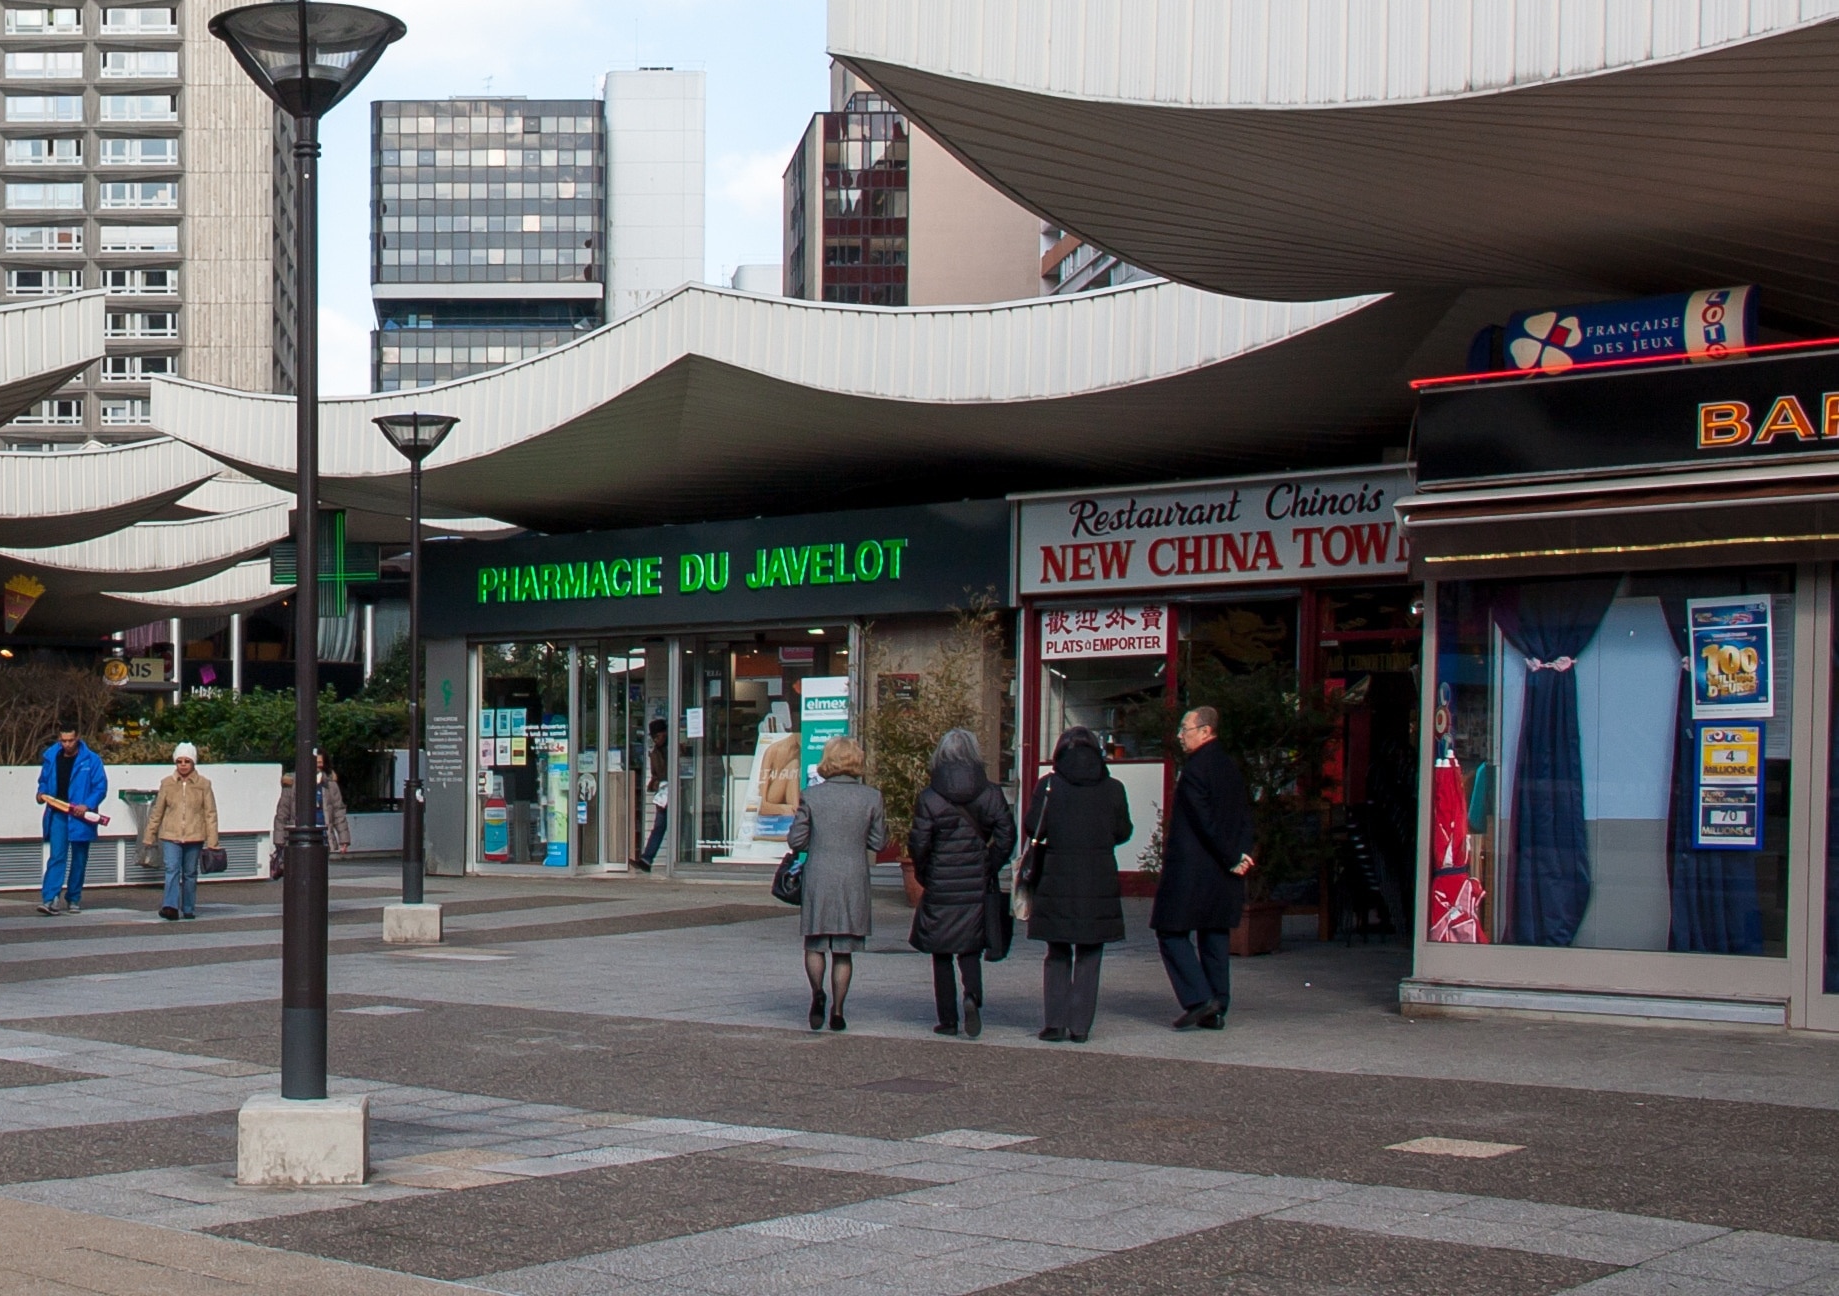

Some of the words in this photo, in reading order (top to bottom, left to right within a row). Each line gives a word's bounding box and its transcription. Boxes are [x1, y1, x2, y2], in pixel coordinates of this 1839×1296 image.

[1586, 316, 1680, 338] FRANÇAISE
[1593, 340, 1624, 355] DES
[1632, 335, 1673, 352] JEUX
[1068, 489, 1240, 538] Restaurant
[1265, 482, 1384, 521] Chinois
[1040, 539, 1136, 584] NEW
[1147, 530, 1284, 577] CHINA
[477, 556, 662, 603] PHARMACIE
[680, 551, 729, 593] DU
[746, 537, 908, 591] JAVELOT
[1046, 639, 1084, 654] PLATS
[1093, 635, 1161, 652] EMPORTER
[1701, 644, 1759, 675] 100
[806, 698, 847, 710] elmex
[1725, 750, 1735, 763] 4
[1705, 765, 1747, 775] MILLIONS
[1722, 810, 1738, 823] 70
[1702, 825, 1745, 836] MILLIONS
